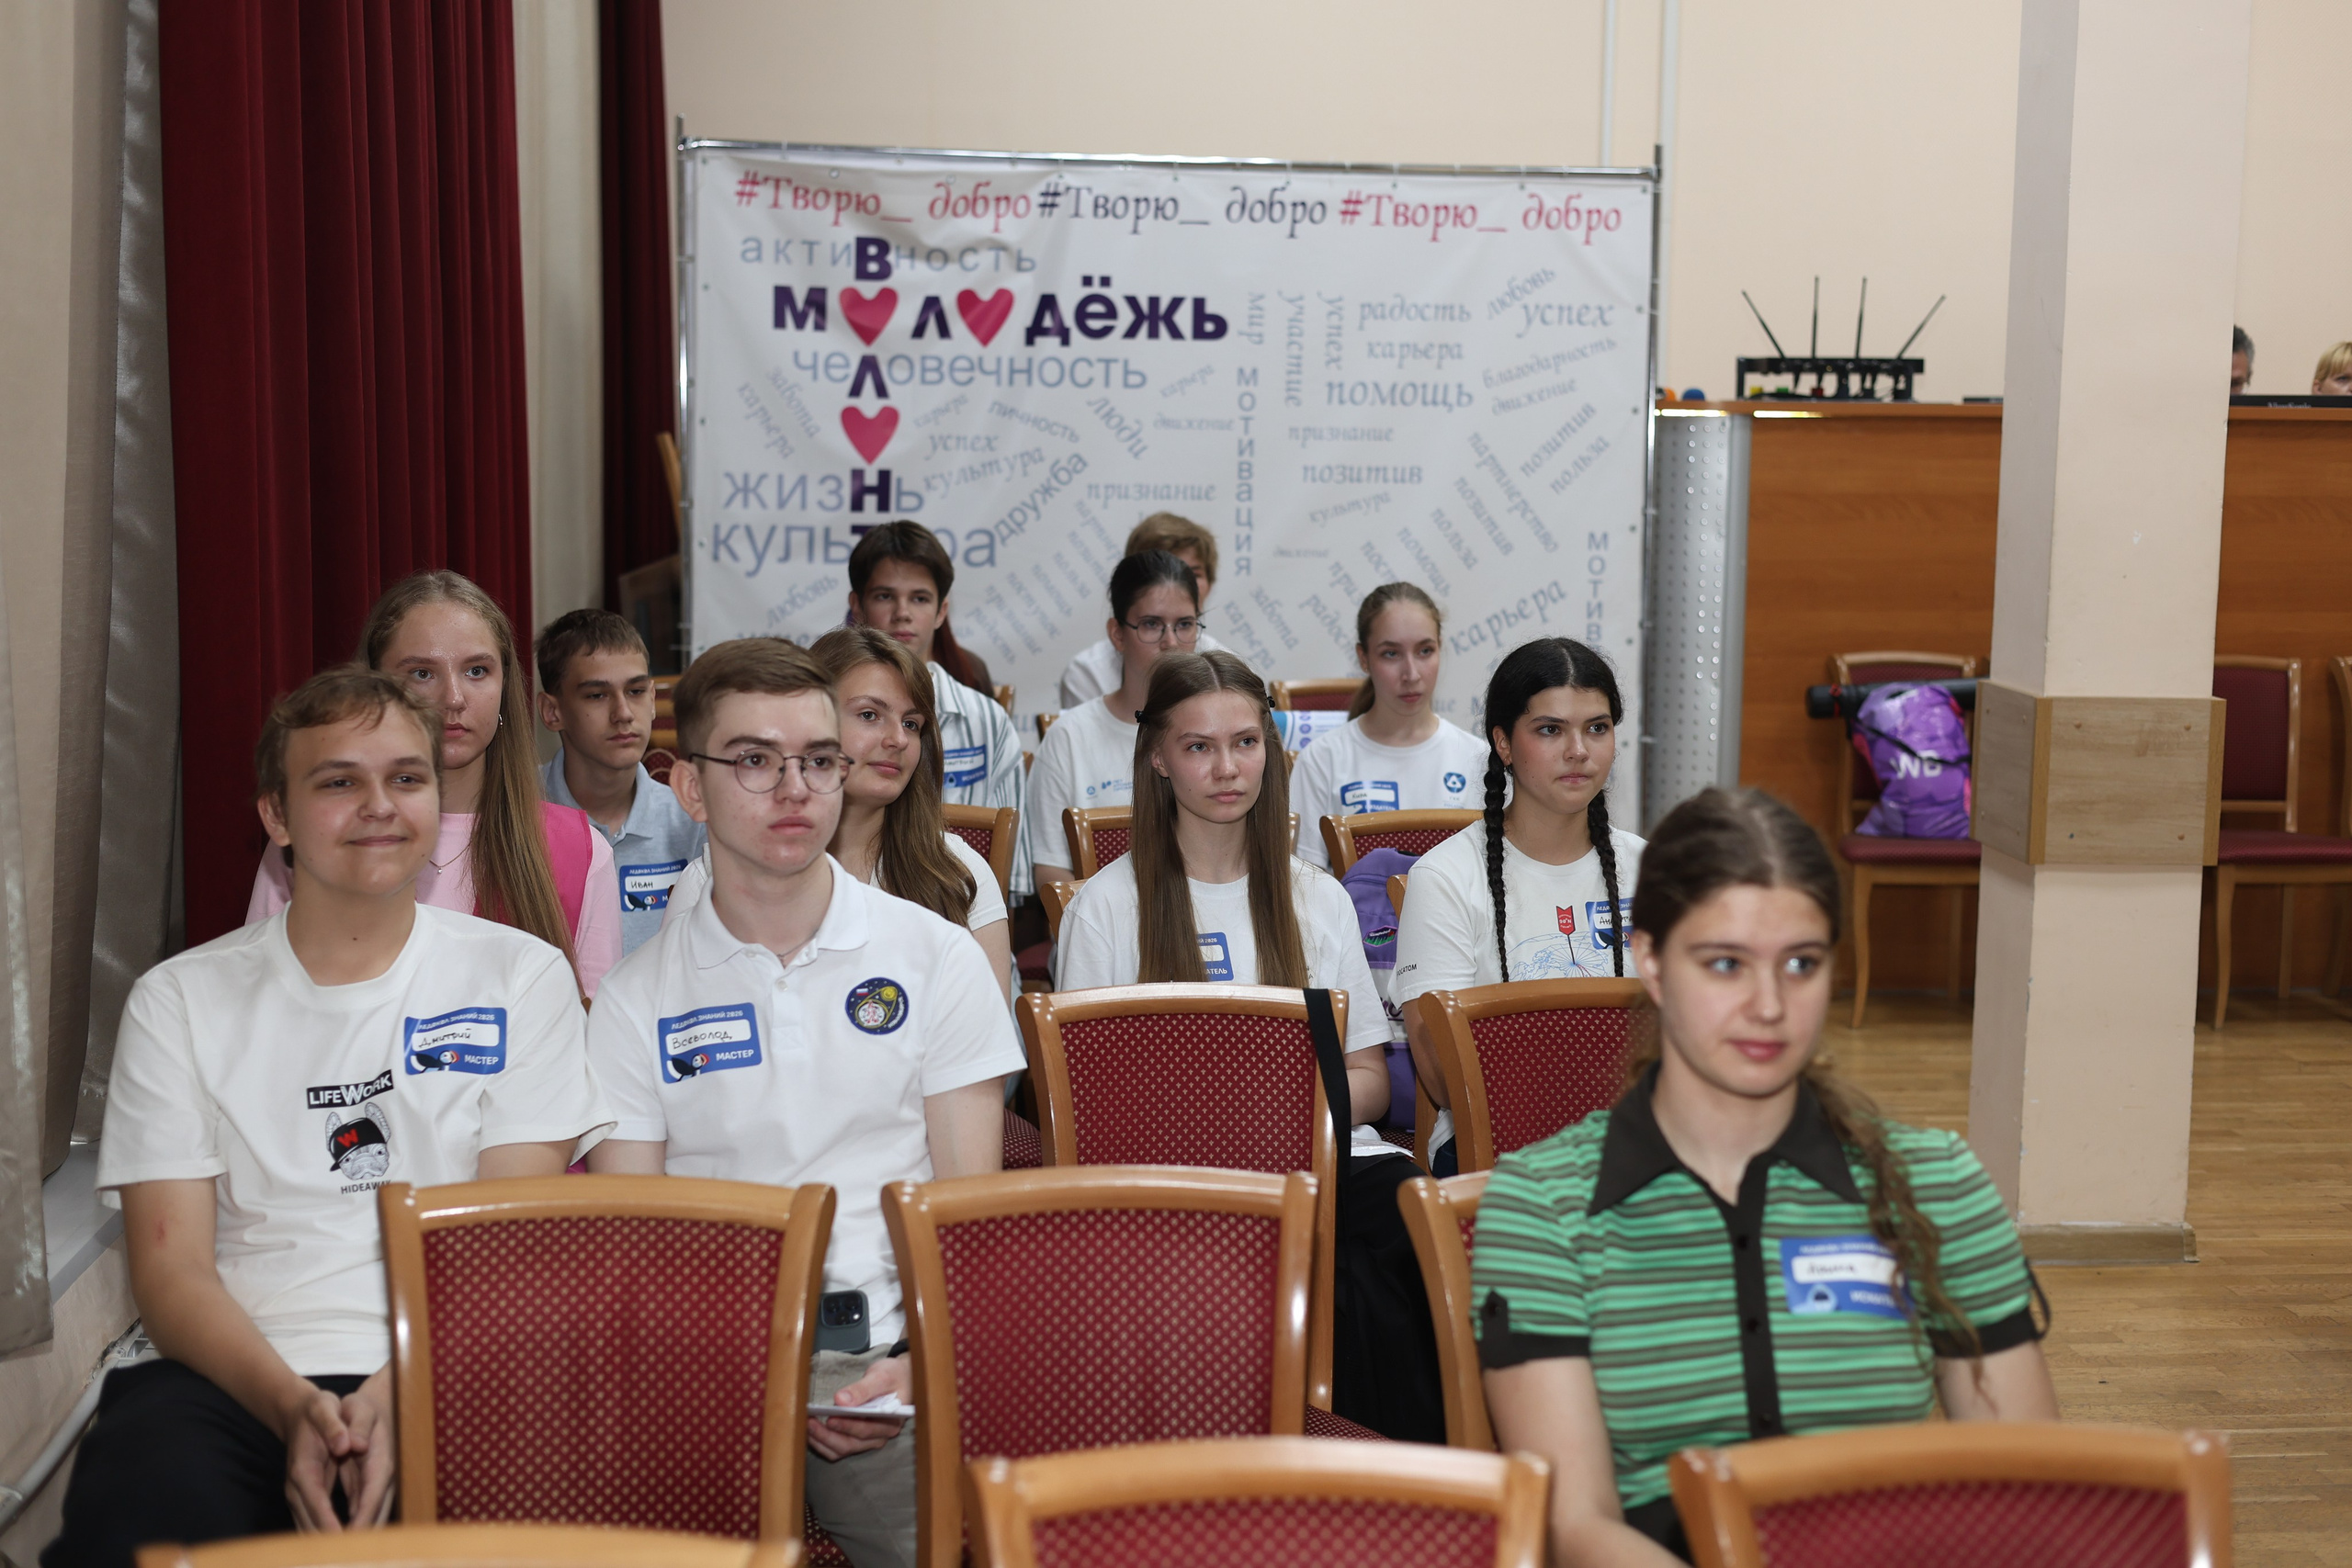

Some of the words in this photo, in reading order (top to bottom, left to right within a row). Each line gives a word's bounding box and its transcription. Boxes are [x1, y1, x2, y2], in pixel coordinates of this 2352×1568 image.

[928, 181, 1032, 232] добро
[1225, 182, 1328, 239] добро
[1522, 193, 1622, 245] добро
[1238, 291, 1265, 346] мир
[1358, 294, 1472, 332] радость
[1487, 267, 1555, 321] любовь
[1515, 302, 1615, 339] успех
[1277, 289, 1306, 408] участие
[1317, 291, 1345, 370] успех
[1366, 340, 1464, 369] карьера
[794, 349, 1148, 395] человечность
[1326, 379, 1474, 412] помощь
[1492, 378, 1577, 416] движение
[737, 382, 796, 459] карьера
[763, 366, 820, 439] забота
[988, 400, 1080, 443] личность
[1086, 397, 1148, 459] люди
[923, 434, 999, 461] успех
[1288, 426, 1395, 448] признание
[1520, 401, 1597, 478] позитив
[723, 468, 925, 513] жизнь
[923, 446, 1045, 499] культура
[1235, 367, 1259, 576] мотивация
[1302, 464, 1423, 485] позитив
[1549, 434, 1611, 495] польза
[994, 453, 1088, 547] дружба
[1087, 483, 1217, 509] признание
[1453, 475, 1514, 557] позитив
[1396, 525, 1452, 598] помощь
[1430, 508, 1479, 571] польза
[766, 575, 839, 628] любовь
[1249, 584, 1300, 650] забота
[1448, 579, 1567, 656] карьера
[1224, 600, 1275, 670] карьера
[464, 1054, 499, 1066] МАСТЕР
[716, 1049, 754, 1062] МАСТЕР
[341, 1179, 390, 1195] HIDEAW
